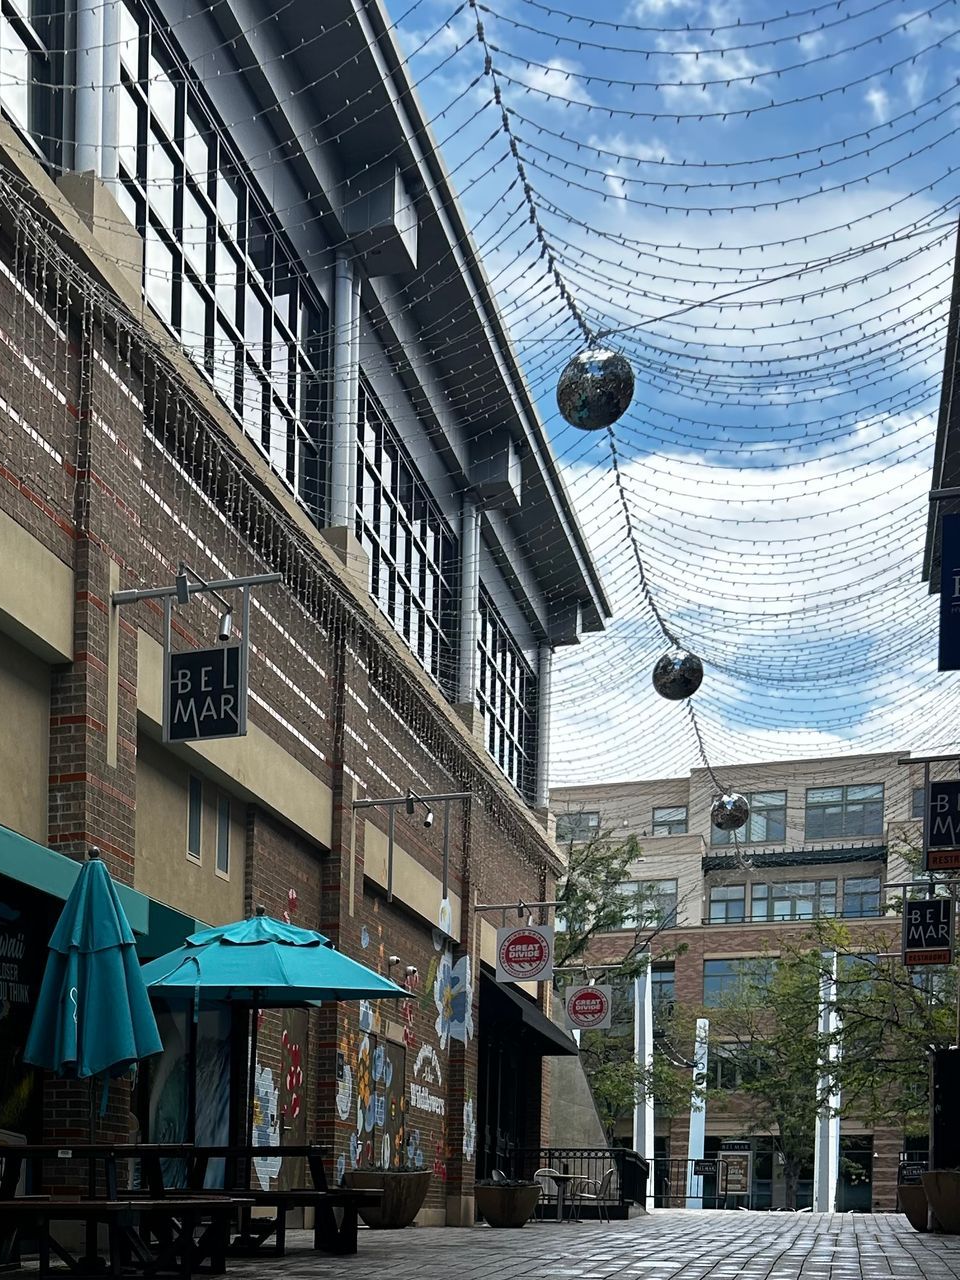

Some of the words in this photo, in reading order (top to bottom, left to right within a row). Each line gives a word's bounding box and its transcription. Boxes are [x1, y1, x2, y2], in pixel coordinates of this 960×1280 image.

[171, 648, 235, 694] BEL
[173, 694, 239, 737] MAR
[932, 855, 960, 865] RESTR
[907, 900, 948, 924] BEL
[909, 924, 950, 947] MAR
[509, 944, 540, 952] GREAT
[509, 950, 540, 958] DIVIDE
[9, 982, 30, 1003] THINK
